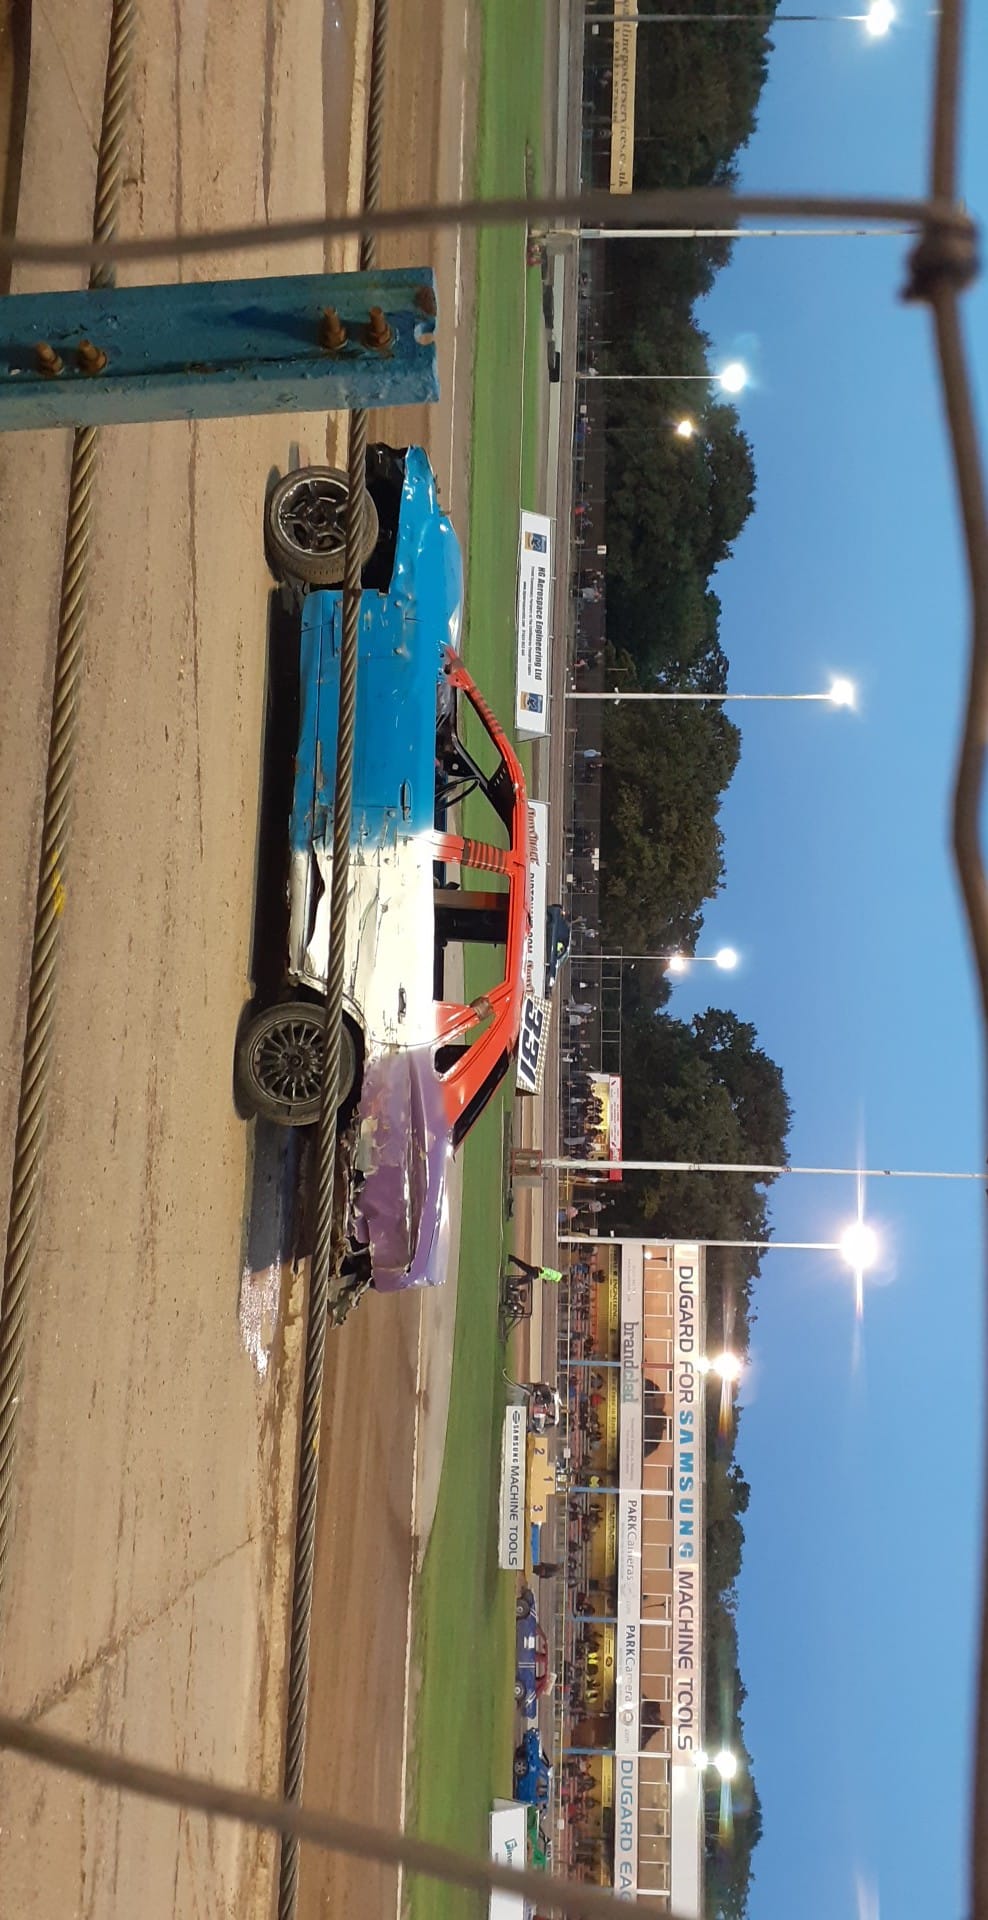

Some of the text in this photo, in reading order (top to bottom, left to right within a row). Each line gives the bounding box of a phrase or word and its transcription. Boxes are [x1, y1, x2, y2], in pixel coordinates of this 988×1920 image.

[536, 578, 546, 619] Aerospace
[534, 621, 544, 667] Engineering
[534, 668, 543, 681] Ltd
[520, 999, 544, 1083] 331
[623, 1322, 639, 1403] brandclad
[535, 1447, 545, 1455] 2
[510, 1465, 520, 1521] MACHINE
[677, 1266, 694, 1751] DUGARD FOR SAMSUNG MACHINE TOOLS
[509, 1525, 518, 1566] TOOLS
[625, 1625, 636, 1705] PARKCamera
[620, 1760, 633, 1852] DUGARD
